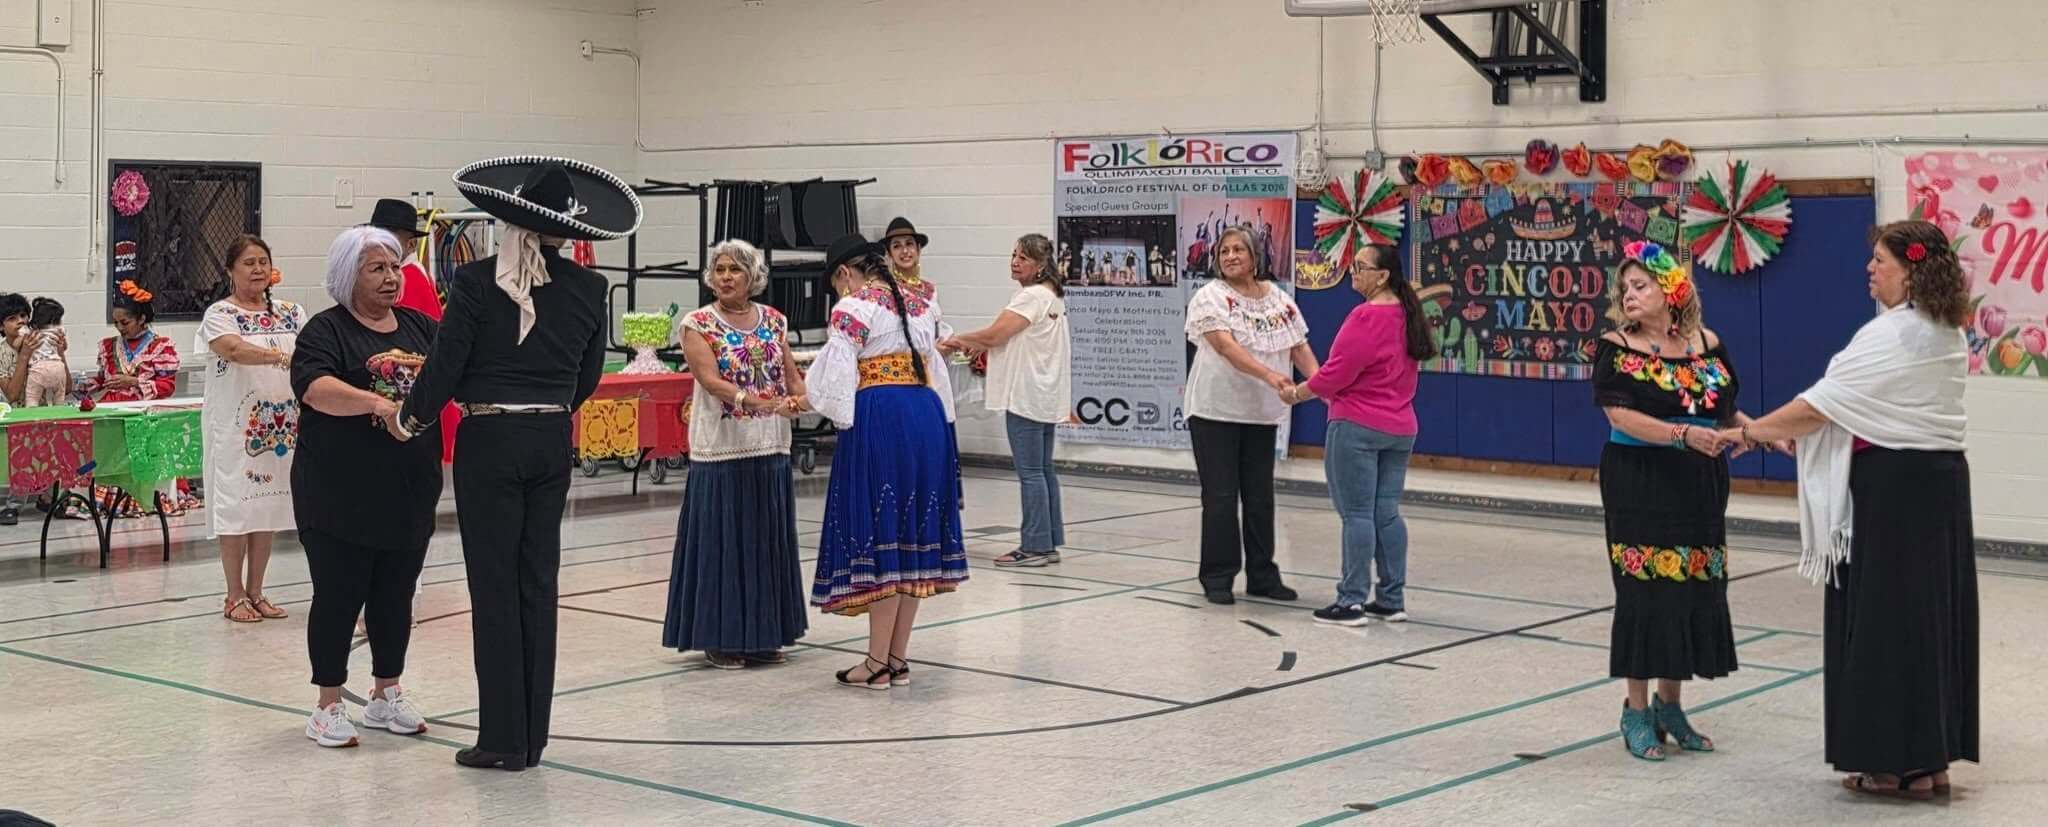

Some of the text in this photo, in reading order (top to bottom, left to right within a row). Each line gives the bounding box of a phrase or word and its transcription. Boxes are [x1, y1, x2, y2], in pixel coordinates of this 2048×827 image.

[1192, 168, 1248, 176] BALLET
[1066, 184, 1133, 195] FOLKLORICO
[1136, 183, 1188, 194] FESTIVAL
[1192, 183, 1208, 193] OF
[1212, 183, 1257, 193] DALLAS
[1065, 202, 1099, 213] Special
[1132, 201, 1169, 212] Groups
[1505, 239, 1585, 263] HAPPY
[1089, 306, 1111, 315] Mayo
[1163, 308, 1181, 317] Day
[1495, 299, 1595, 332] MAYO
[1094, 317, 1147, 326] Celebration
[1074, 327, 1108, 336] Saturday
